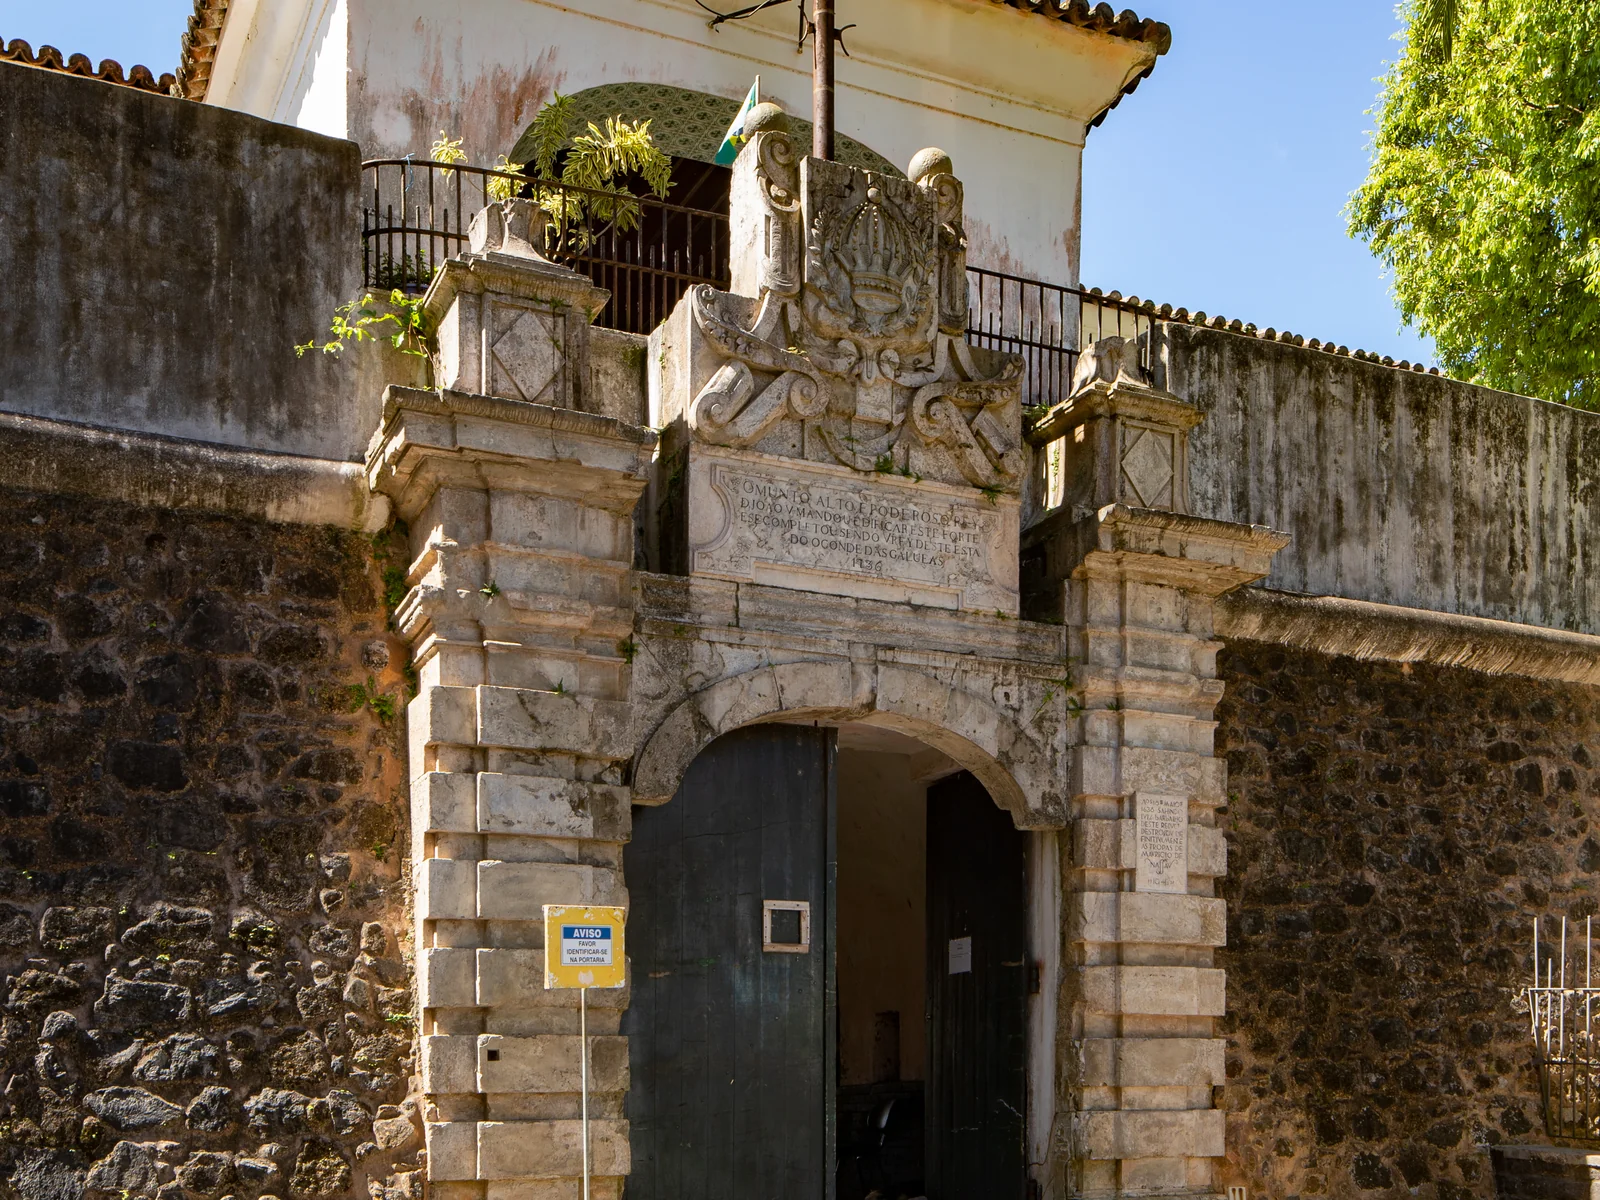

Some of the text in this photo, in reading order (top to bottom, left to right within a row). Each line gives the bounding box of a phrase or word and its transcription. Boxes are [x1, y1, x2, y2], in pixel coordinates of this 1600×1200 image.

[797, 507, 851, 525] MANDOU
[910, 525, 939, 539] ESTE
[942, 530, 979, 544] FORTE
[790, 534, 808, 546] DO
[864, 545, 887, 558] DAS
[840, 528, 880, 542] SENDO
[916, 539, 952, 554] DESTE
[954, 545, 980, 557] ESTA
[852, 557, 883, 572] 1736
[1149, 843, 1172, 851] TROPAS
[573, 929, 602, 938] AVISO
